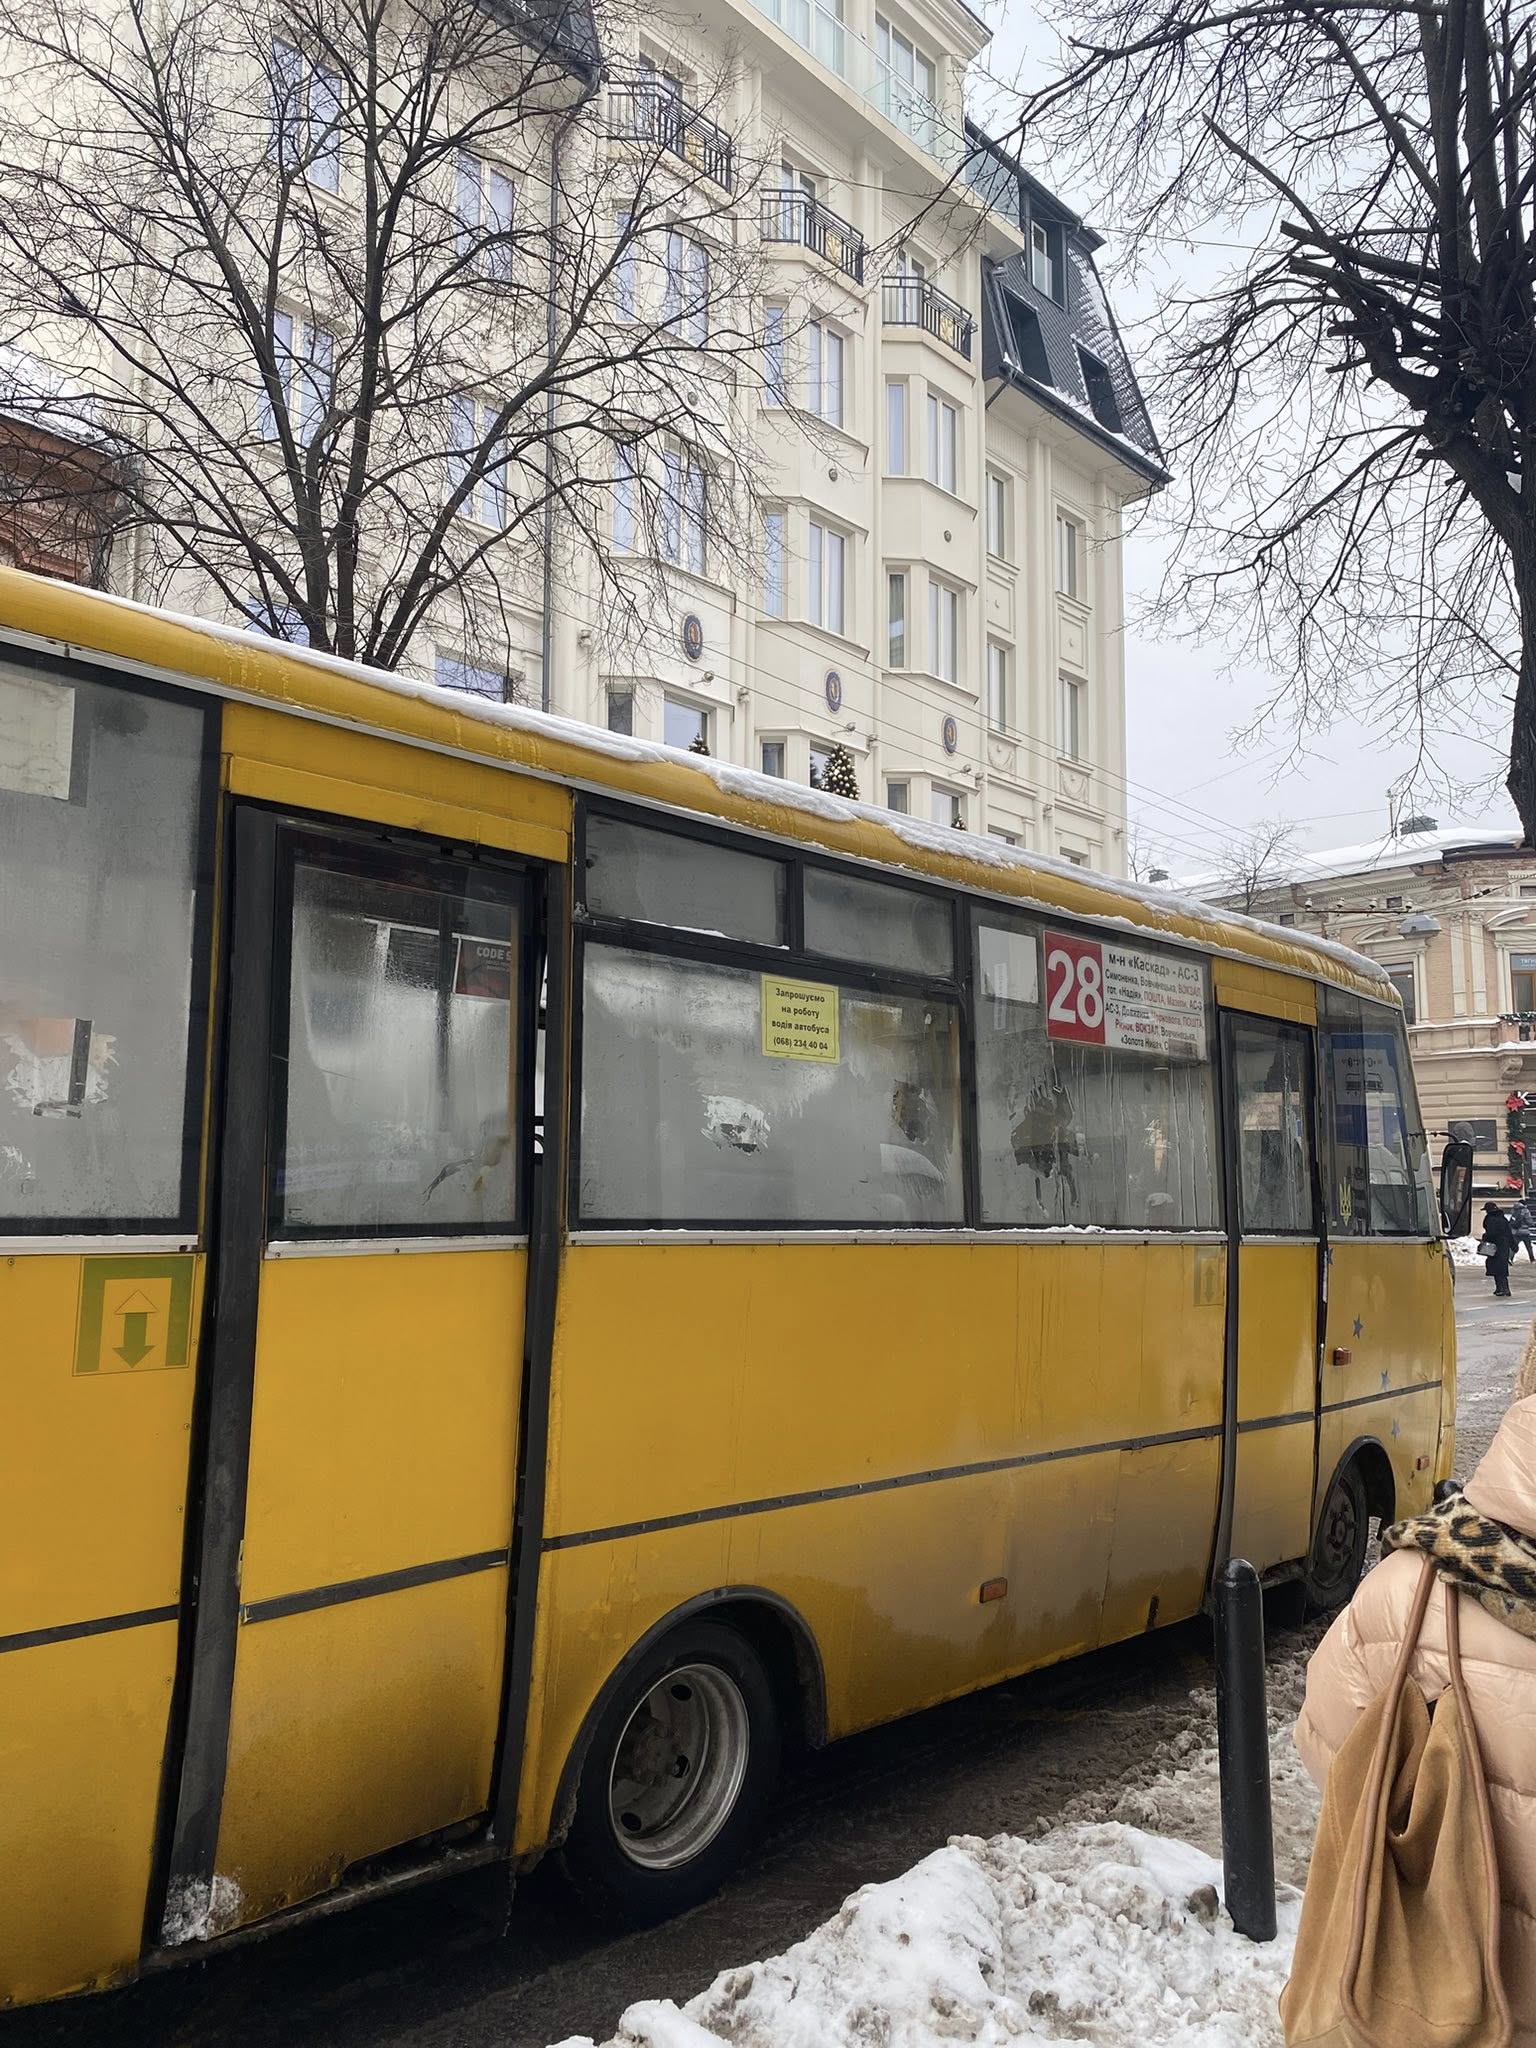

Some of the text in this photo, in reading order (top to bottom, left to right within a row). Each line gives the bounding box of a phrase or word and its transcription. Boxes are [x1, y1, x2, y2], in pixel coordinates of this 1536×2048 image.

[476, 946, 505, 960] CODE
[1128, 955, 1170, 977] «Каскад»
[1177, 966, 1199, 982] АС-3
[1047, 949, 1105, 1029] 28
[781, 1006, 820, 1019] на роботу
[771, 1020, 830, 1035] водія автобуса
[793, 1039, 807, 1049] 234
[808, 1040, 818, 1049] 40
[818, 1042, 828, 1051] 04
